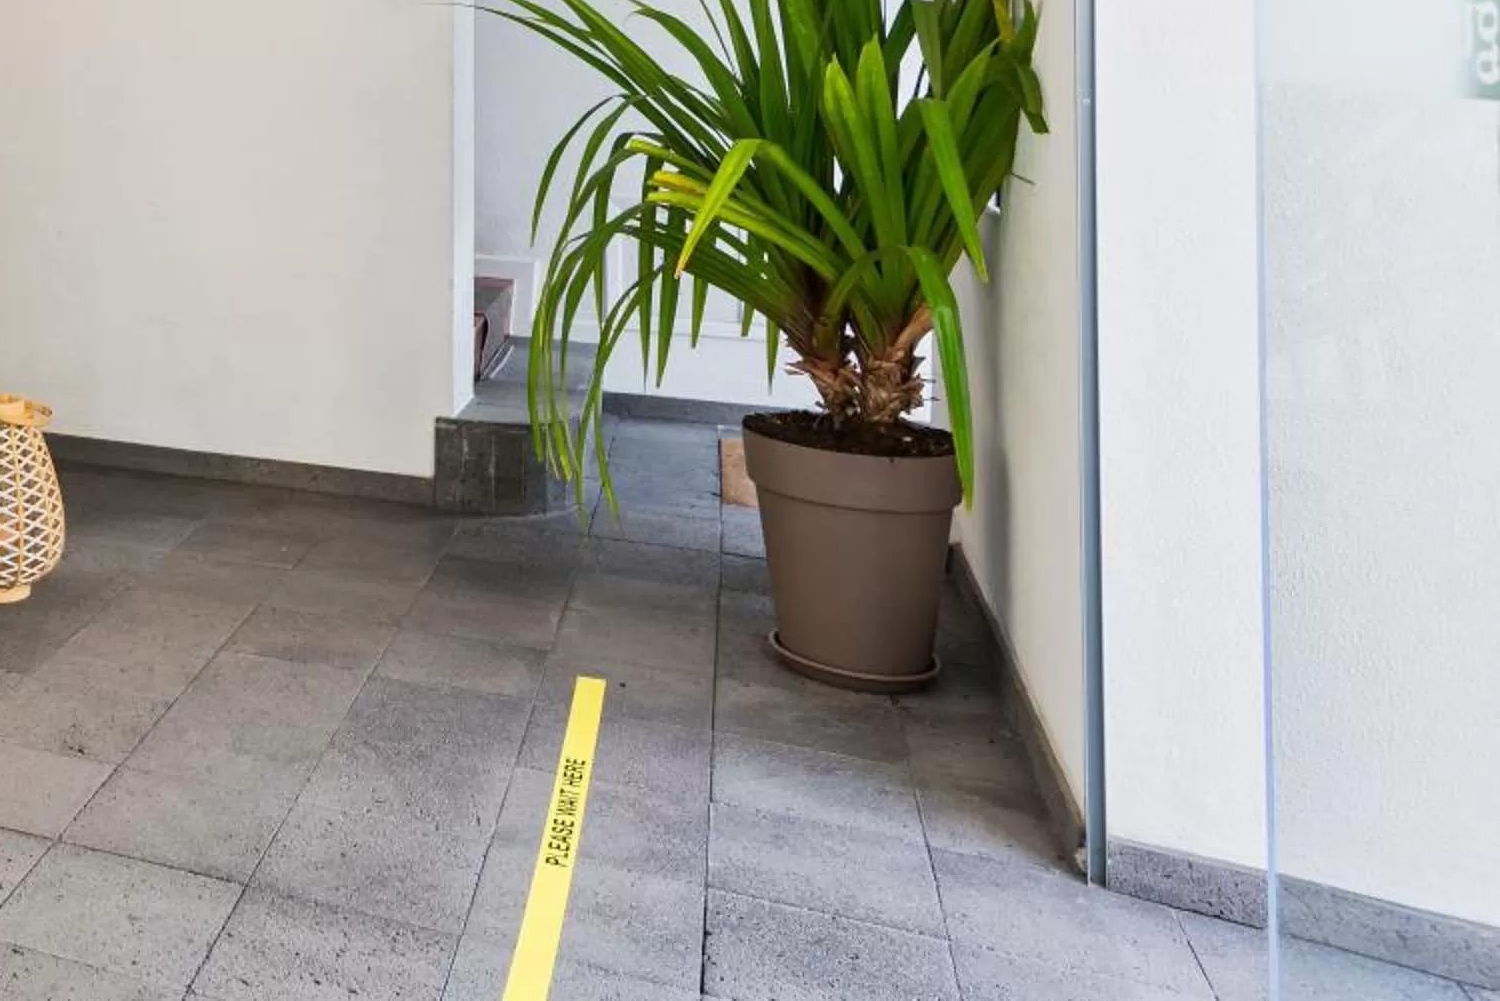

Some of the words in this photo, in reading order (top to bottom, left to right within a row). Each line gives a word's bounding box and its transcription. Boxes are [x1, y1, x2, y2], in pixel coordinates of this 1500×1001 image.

[563, 758, 586, 787] HERE
[556, 789, 580, 816] WAIT
[545, 818, 574, 867] PLEASE
